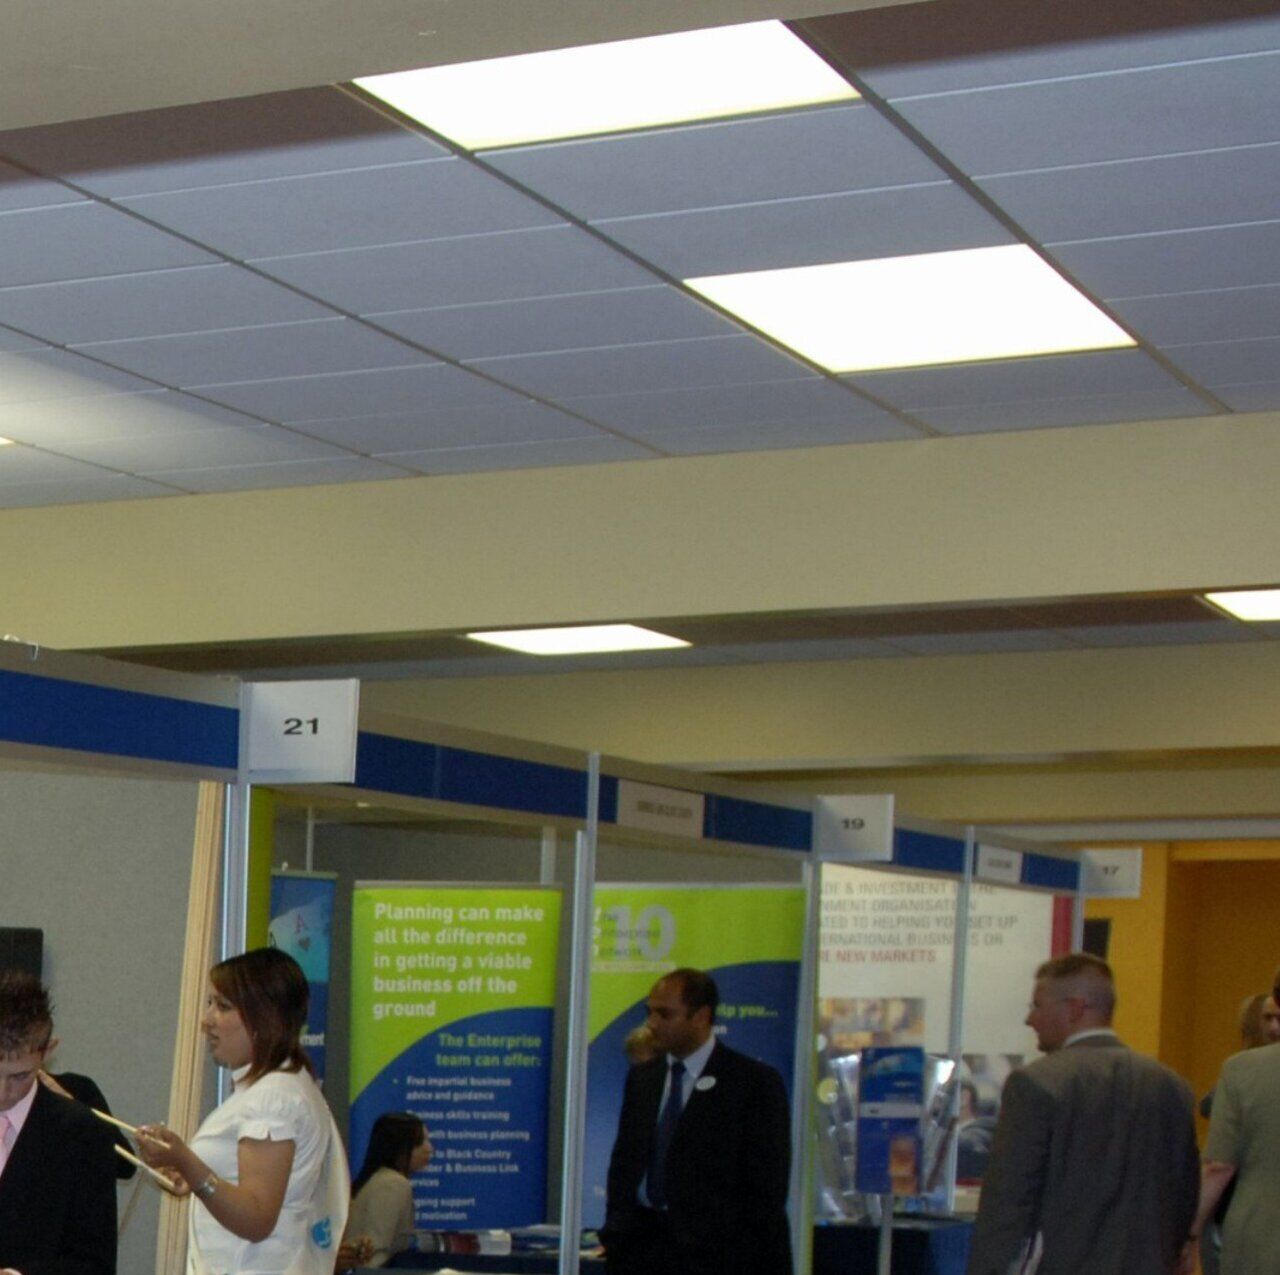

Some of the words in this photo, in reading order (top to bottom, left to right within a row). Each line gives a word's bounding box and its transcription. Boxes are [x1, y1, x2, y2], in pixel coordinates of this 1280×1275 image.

[283, 718, 319, 735] 21
[376, 903, 453, 923] Planning
[458, 907, 490, 920] can
[496, 906, 544, 921] make
[374, 929, 397, 944] all
[403, 929, 431, 944] the
[436, 929, 527, 945] difference
[374, 952, 389, 968] in
[396, 953, 457, 972] getting
[462, 956, 472, 968] a
[478, 952, 532, 969] viable
[836, 949, 866, 962] NEW
[870, 949, 938, 963] MARKETS
[374, 976, 452, 992] business
[457, 976, 482, 992] off
[487, 977, 517, 993] the
[373, 1001, 436, 1020] ground
[440, 1033, 464, 1047] The
[467, 1033, 542, 1049] Enterprise
[436, 1054, 471, 1066] team
[475, 1056, 499, 1066] can
[503, 1053, 541, 1067] offer:
[471, 1077, 512, 1086] business
[406, 1091, 433, 1100] advice
[435, 1091, 450, 1100] and
[453, 1091, 494, 1102] guidance
[446, 1110, 471, 1120] skills
[473, 1111, 510, 1121] training
[448, 1130, 488, 1140] business
[490, 1130, 530, 1141] planning
[446, 1149, 472, 1159] Black
[474, 1149, 512, 1160] Country
[455, 1164, 497, 1174] Business
[499, 1164, 519, 1174] Link
